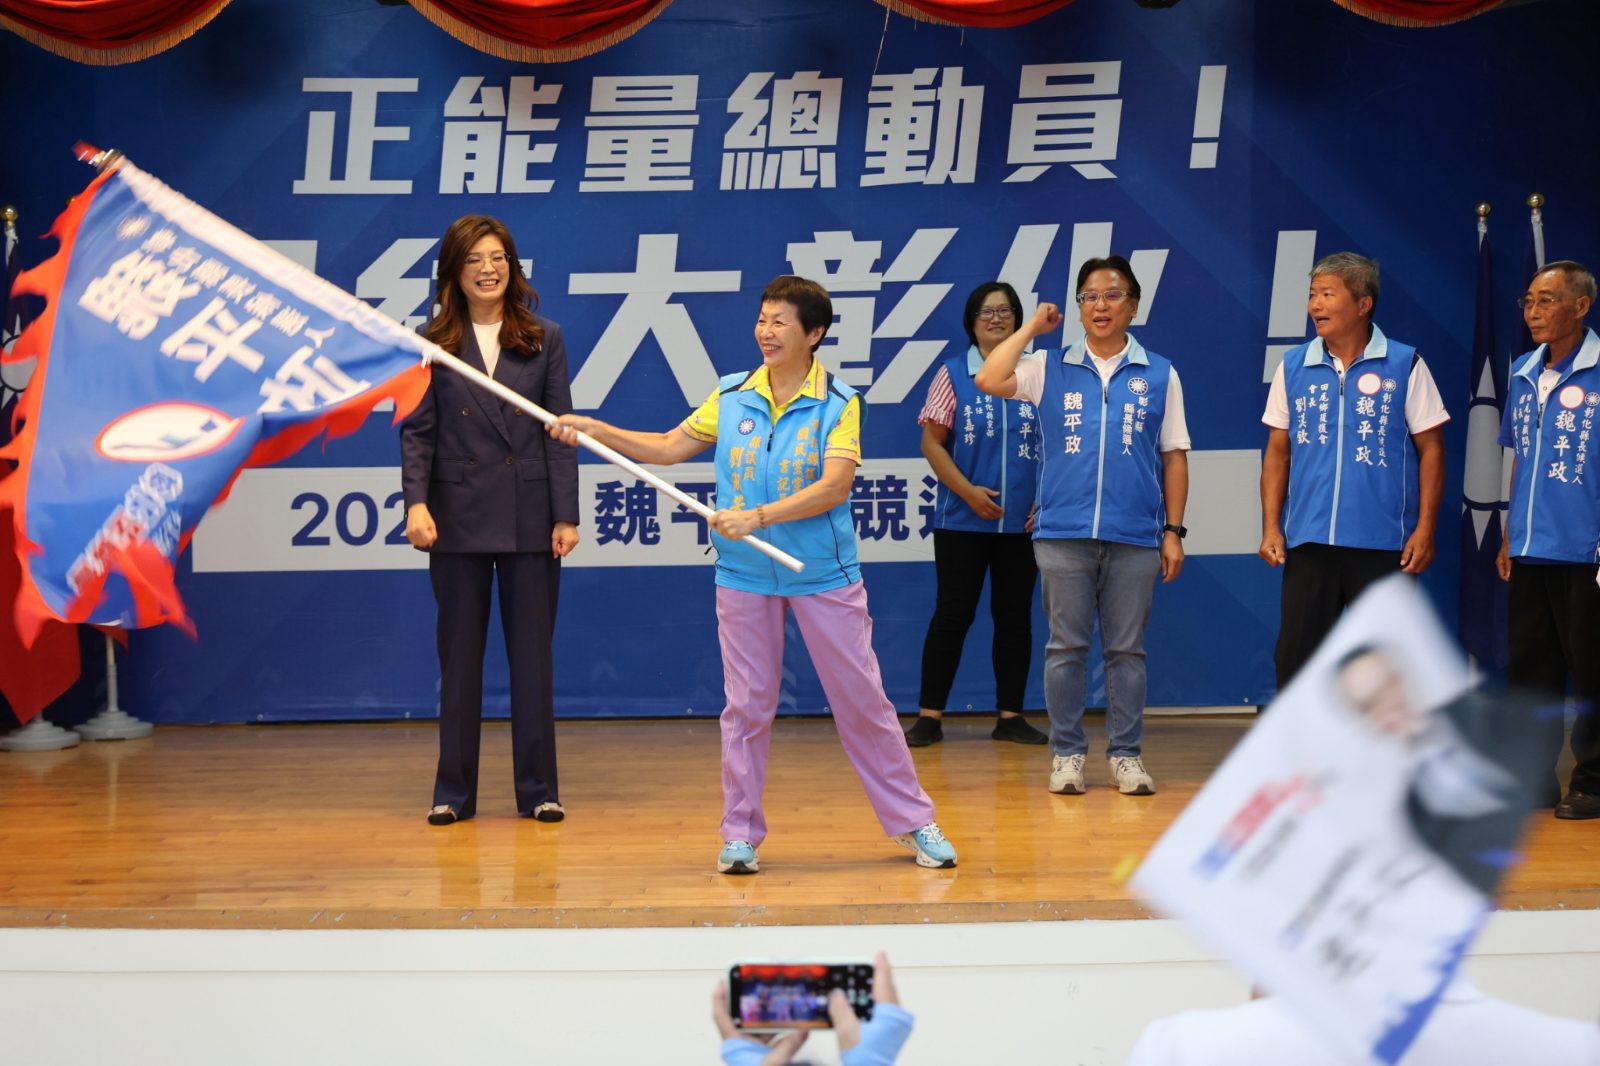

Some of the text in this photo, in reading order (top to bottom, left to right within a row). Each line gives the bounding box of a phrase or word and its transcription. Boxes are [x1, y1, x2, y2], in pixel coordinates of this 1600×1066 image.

[293, 61, 1227, 195] 正能量總動員！
[1063, 391, 1083, 455] 魏平政
[1122, 402, 1135, 456] 縣長候選人
[1134, 396, 1149, 433] 彰化縣
[1308, 384, 1318, 409] 會長
[1377, 392, 1393, 468] 彰化縣長候選人
[1018, 403, 1035, 460] 魏平政
[1355, 396, 1376, 466] 魏平政
[1548, 409, 1577, 483] 魏平政
[1571, 406, 1596, 485] 彰化縣長候選人
